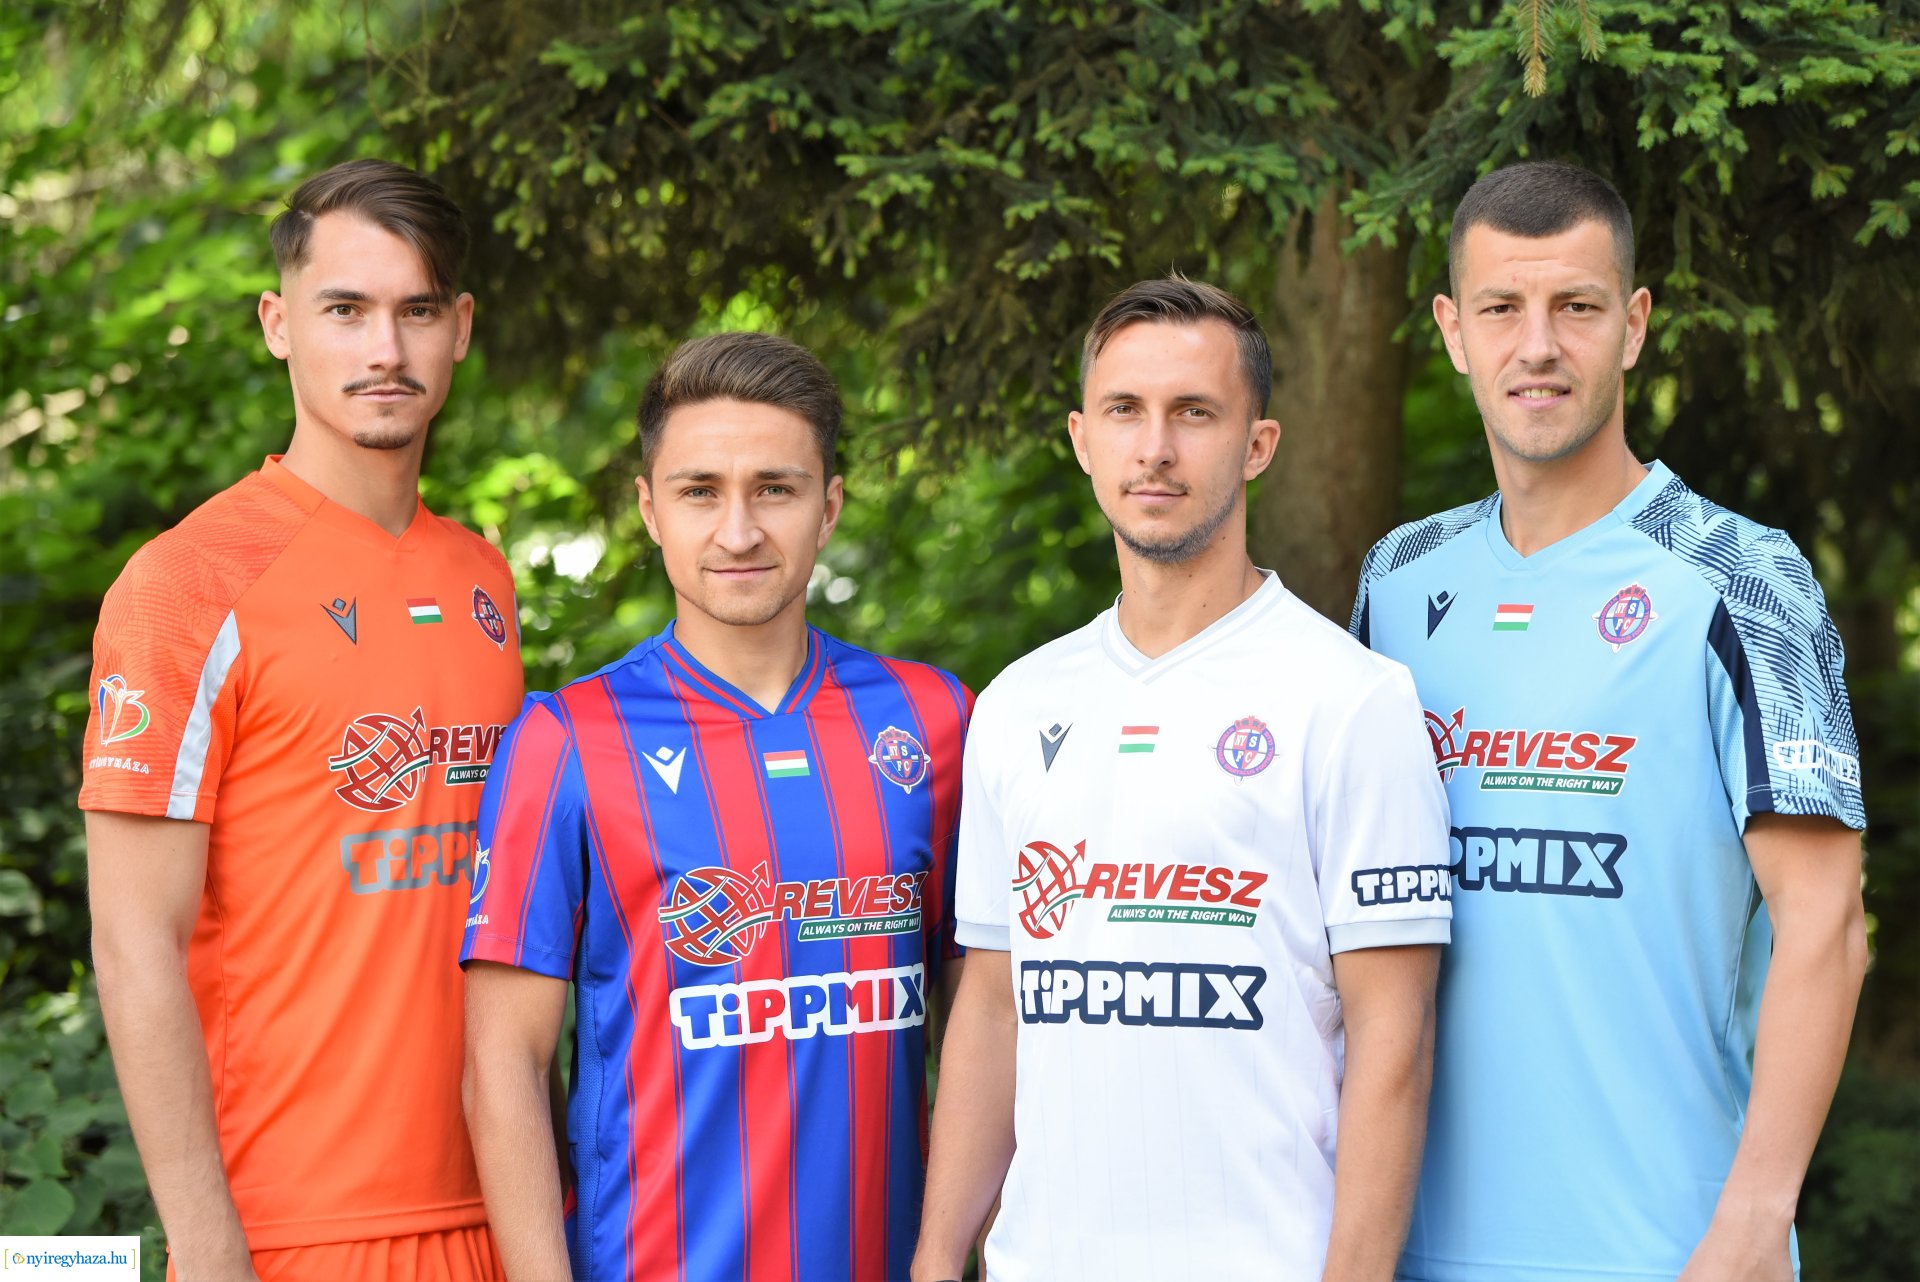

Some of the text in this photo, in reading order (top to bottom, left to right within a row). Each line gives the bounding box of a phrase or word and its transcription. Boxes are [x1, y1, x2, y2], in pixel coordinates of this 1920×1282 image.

[1628, 602, 1637, 615] S
[1623, 619, 1631, 630] C
[1248, 735, 1258, 748] S
[901, 745, 909, 757] S
[1245, 751, 1253, 763] C
[903, 760, 910, 772] C
[449, 768, 489, 780] ALWAYS O
[1484, 775, 1619, 792] ALWAYS ON THE RIGHT WAY
[1111, 908, 1253, 924] ALWAYS ON THE RIGHT WAY
[803, 922, 845, 936] ALWAYS
[847, 922, 861, 933] ON
[864, 920, 883, 932] THE
[885, 919, 908, 931] RIGHT
